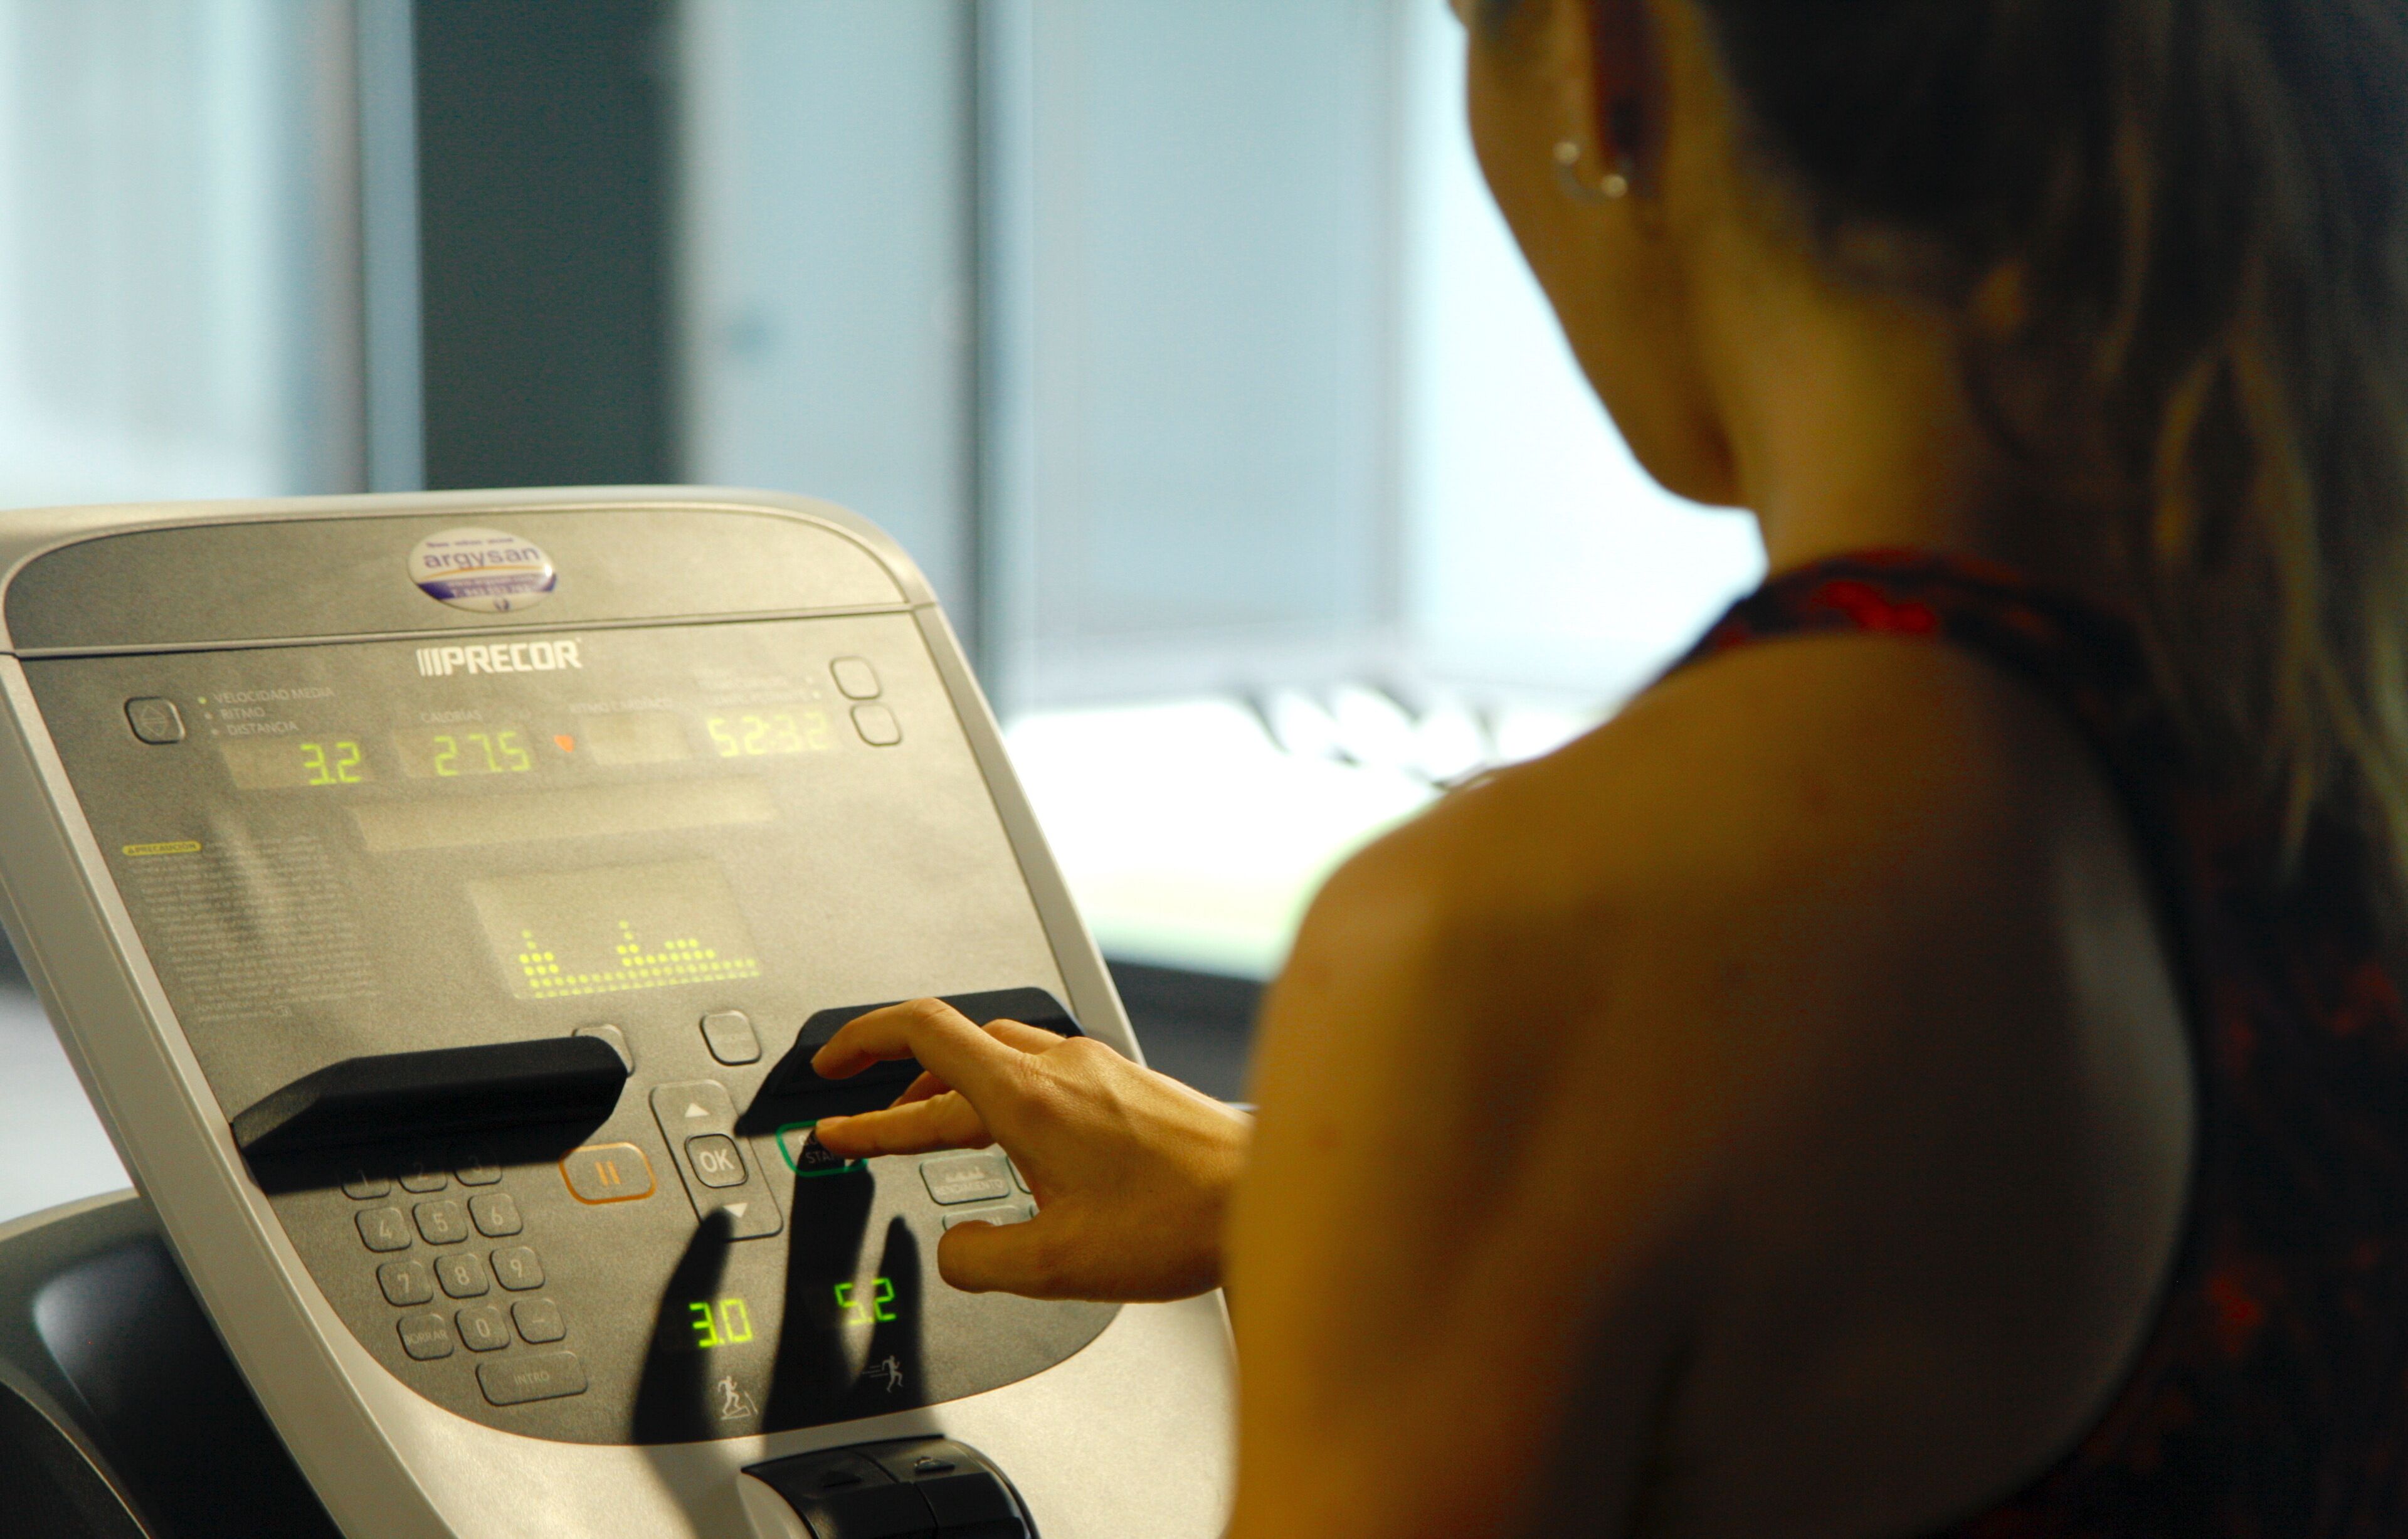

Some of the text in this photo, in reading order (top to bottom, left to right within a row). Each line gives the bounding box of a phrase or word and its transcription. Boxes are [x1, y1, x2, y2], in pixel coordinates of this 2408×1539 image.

[422, 547, 540, 570] argysan
[439, 640, 583, 676] PRECOR
[213, 687, 337, 704] VELOCIDAD MEDIA
[219, 706, 266, 720] RITMO
[226, 721, 300, 736] DISTANCIA
[699, 1149, 735, 1173] OK
[433, 1213, 448, 1232] 5
[491, 1207, 503, 1225] 6
[379, 1220, 393, 1239] 4
[454, 1266, 470, 1286] 8
[510, 1258, 523, 1278] 9
[396, 1273, 409, 1293] 7
[834, 1277, 897, 1326] 5.2
[475, 1318, 491, 1338] 0
[689, 1298, 752, 1348] 3.0
[514, 1370, 550, 1385] INTRO
